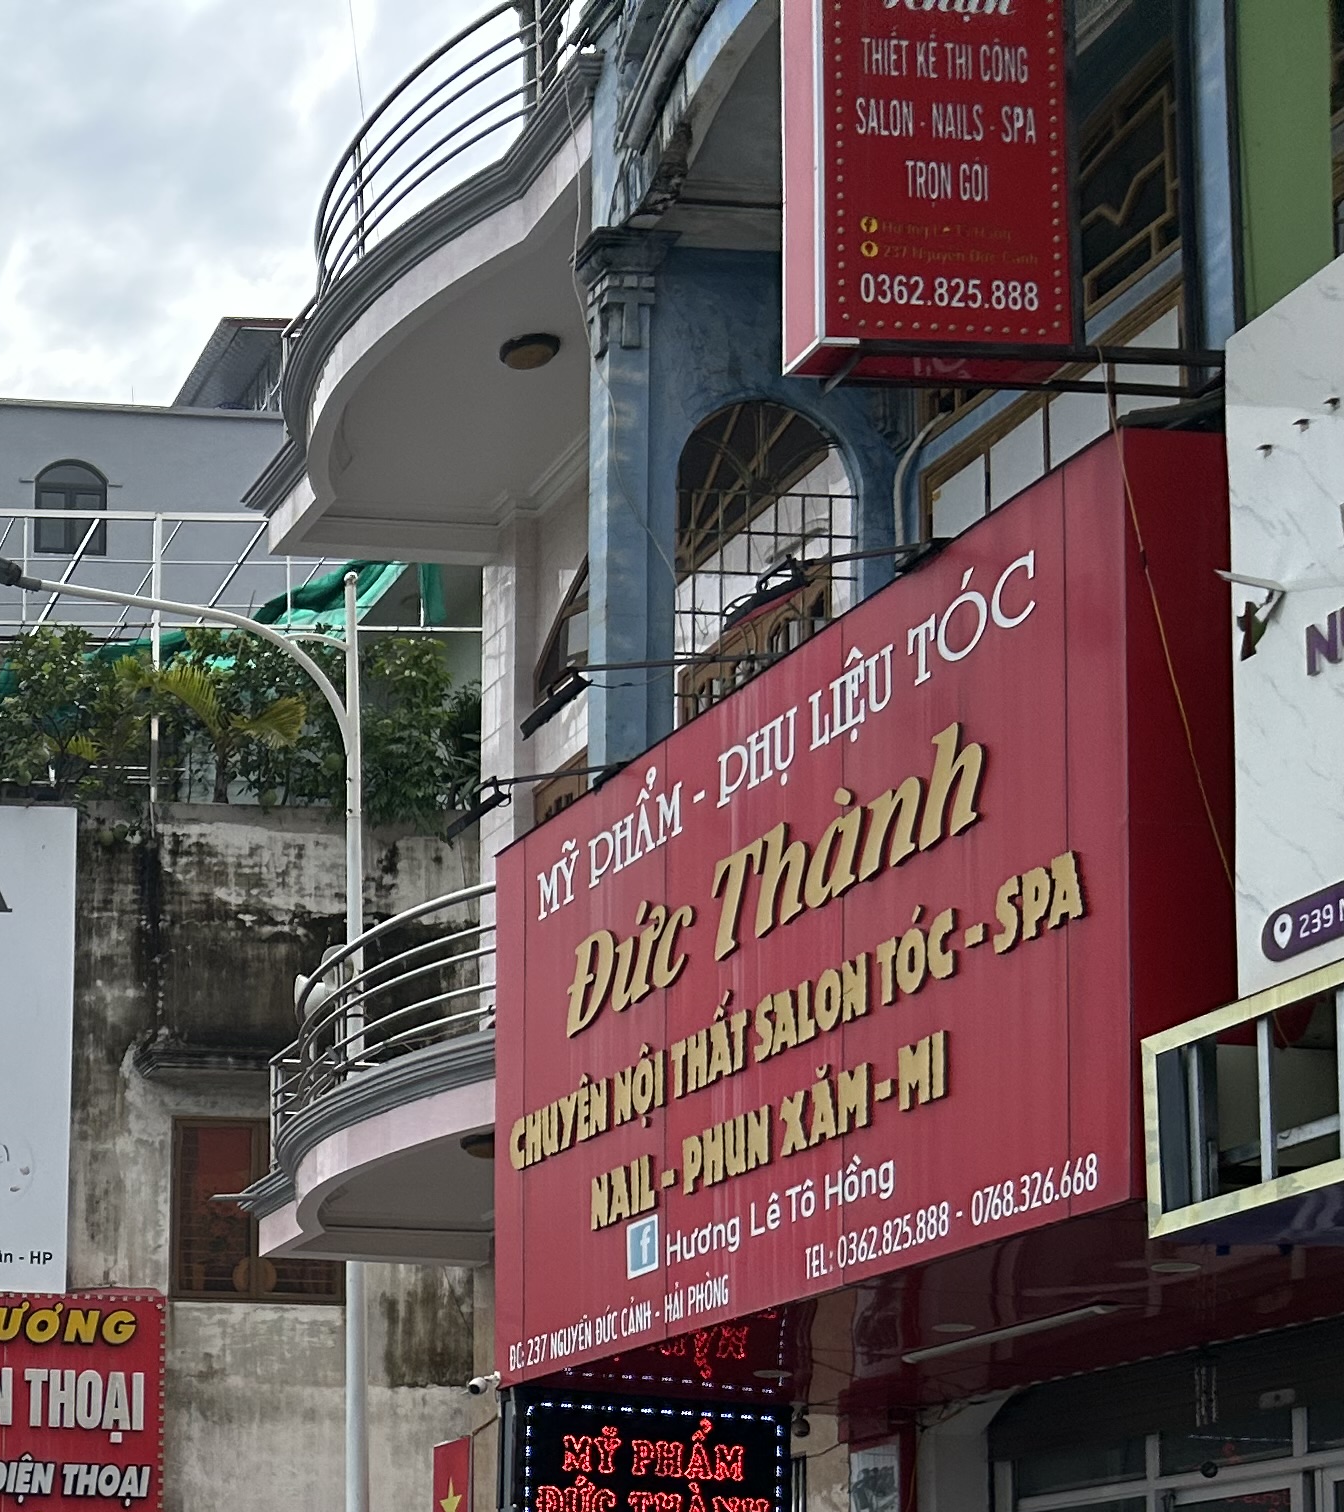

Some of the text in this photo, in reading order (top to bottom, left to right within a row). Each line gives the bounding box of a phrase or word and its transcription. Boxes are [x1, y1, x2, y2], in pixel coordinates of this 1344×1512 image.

[861, 26, 1028, 83] THIẾT KẾ THI CÔNG
[856, 97, 1037, 144] SALON NAILS SPA
[905, 156, 988, 208] TRỌN GÓI
[860, 273, 1039, 312] 0362.825.888
[537, 550, 1036, 920] MỸ PHẨM PHỤ LIỆU TÓC
[566, 721, 988, 1039] Đức Thành
[1299, 910, 1334, 939] 239
[510, 850, 1087, 1171] CHUYÊN NỘI THẤT SALON TÓC SPA
[590, 1030, 950, 1232] NAIL PHUN XĂM MI
[666, 1153, 896, 1266] Hương Lê Tô Hồng
[805, 1153, 1099, 1280] TEL: 0362.825.888 0768.326.668
[29, 1251, 53, 1266] HP
[509, 1271, 729, 1371] ĐC: 237 NGUYỄN ĐỨC CẢNH HẢI PHÒNG
[24, 1368, 145, 1444] THOẠI
[562, 1418, 745, 1481] MỸ PHẨM
[63, 1463, 151, 1507] THOẠI
